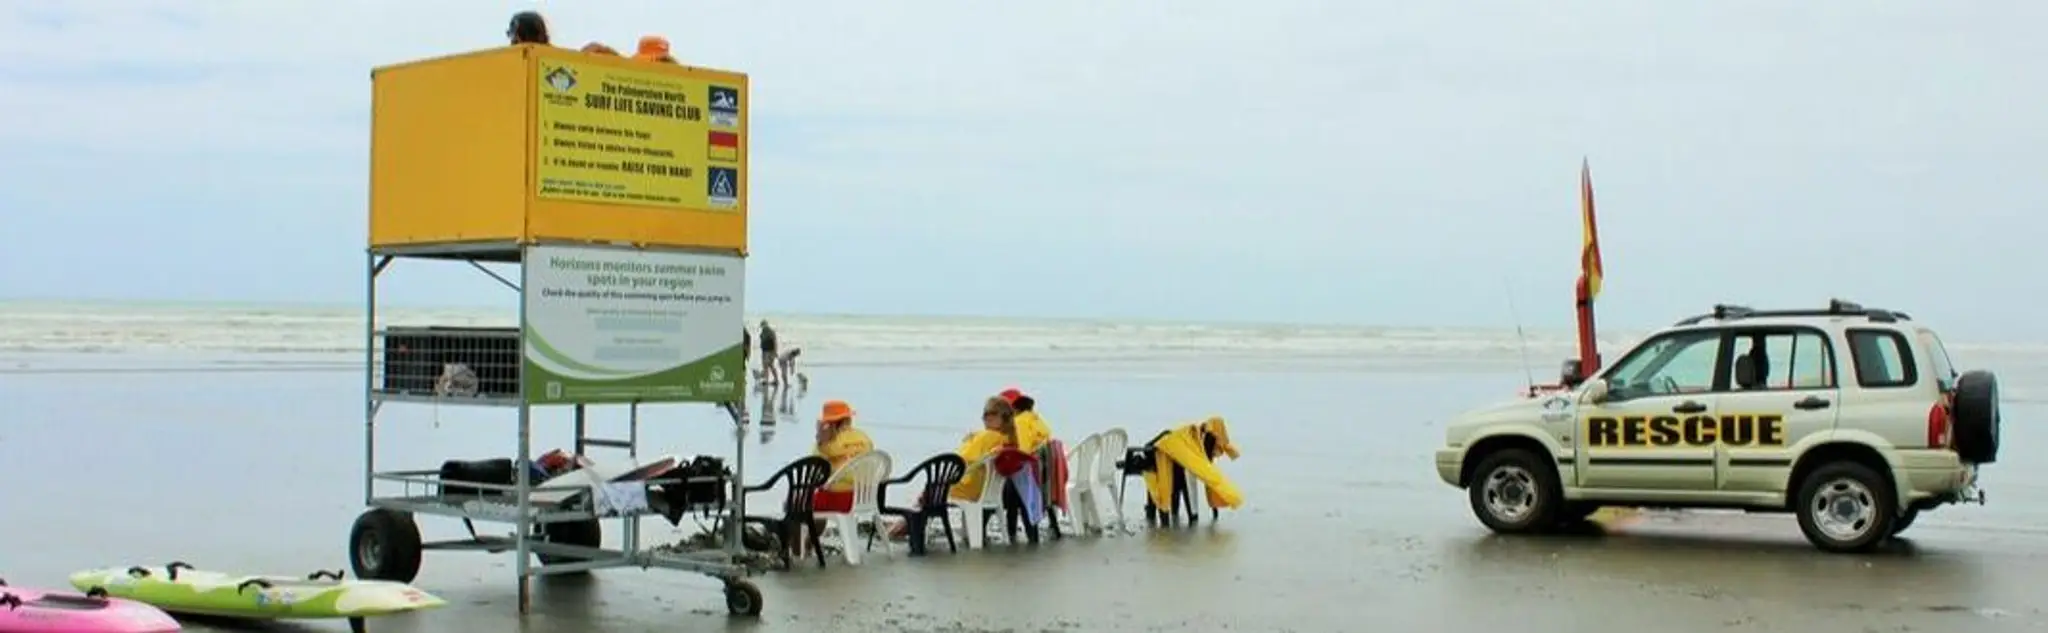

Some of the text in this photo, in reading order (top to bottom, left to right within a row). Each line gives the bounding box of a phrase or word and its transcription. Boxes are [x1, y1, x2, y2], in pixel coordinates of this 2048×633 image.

[602, 81, 616, 95] The
[664, 90, 686, 104] North
[585, 92, 612, 112] SURF
[614, 96, 634, 114] LIFE
[635, 100, 674, 117] SAVING
[675, 104, 702, 122] CLUB
[550, 256, 726, 276] Horizons monitors summer swim
[542, 287, 563, 297] Check
[565, 289, 577, 298] the
[578, 289, 601, 300] quality
[602, 290, 610, 299] of
[587, 274, 693, 292] spots in your region
[1588, 415, 1783, 447] RESCUE
